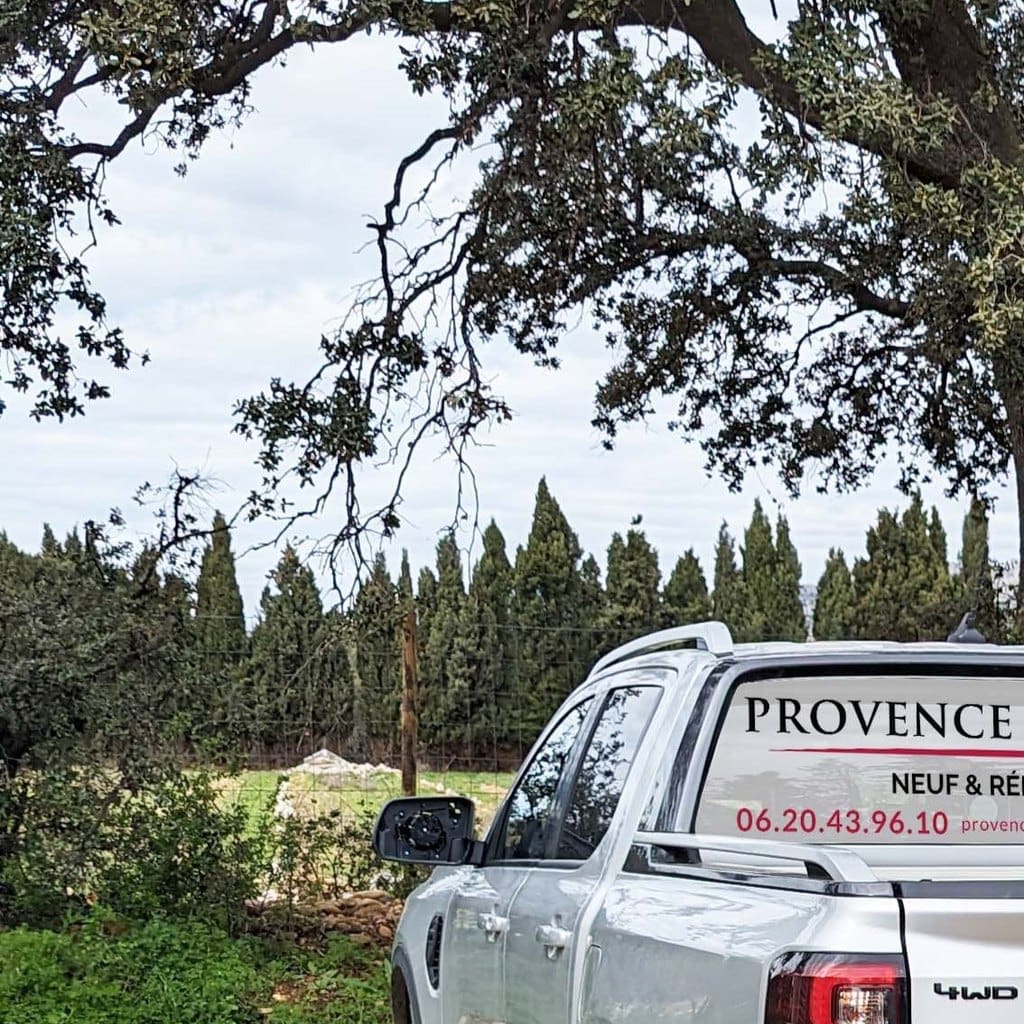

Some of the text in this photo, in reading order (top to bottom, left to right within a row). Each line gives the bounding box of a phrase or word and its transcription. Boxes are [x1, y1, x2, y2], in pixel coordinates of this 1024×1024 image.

[744, 696, 1012, 740] PROVENCE
[892, 772, 959, 795] NEUF
[966, 773, 983, 796] &
[736, 807, 949, 835] 06.20.43.96.10
[933, 982, 1019, 1000] 4WD
